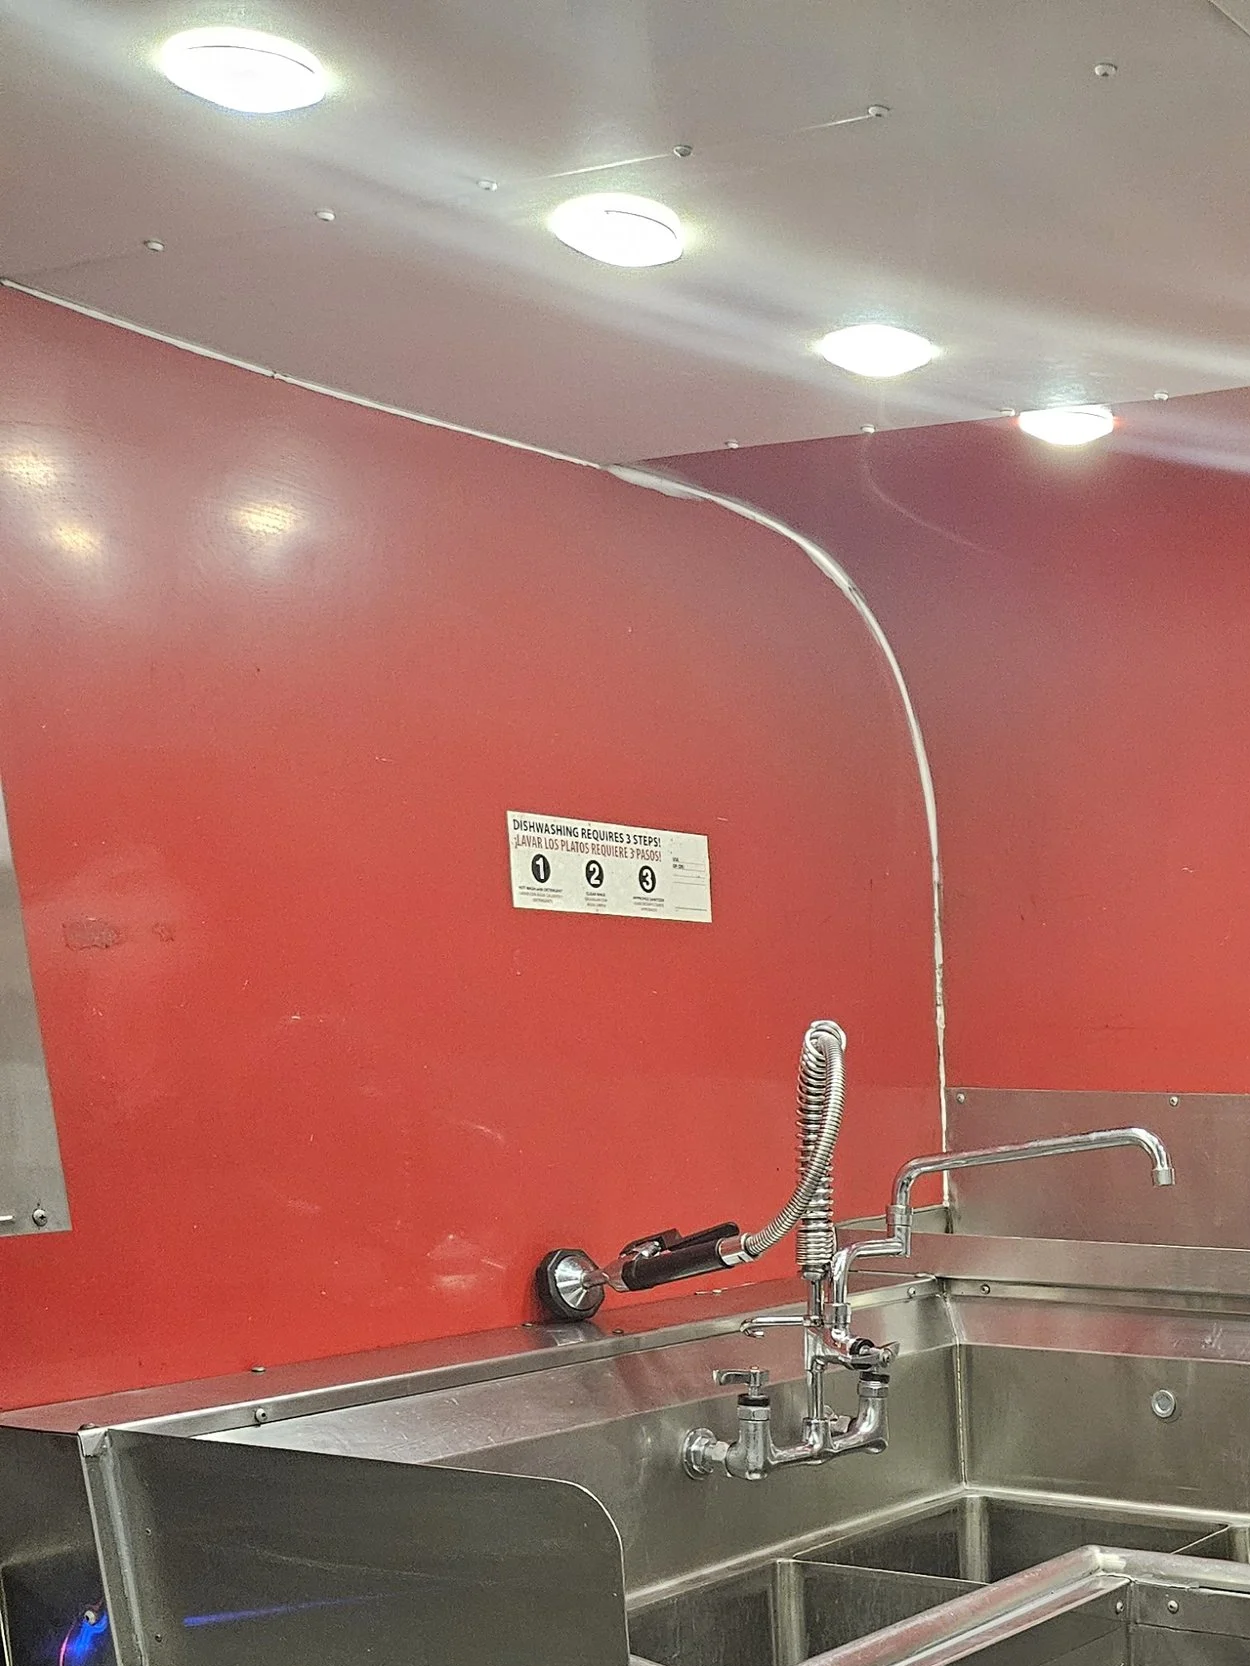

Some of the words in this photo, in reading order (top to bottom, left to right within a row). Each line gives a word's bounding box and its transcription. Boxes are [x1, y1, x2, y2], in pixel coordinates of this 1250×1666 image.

[513, 819, 579, 838] DISHWASHING
[581, 828, 624, 843] REQUIRES
[626, 833, 632, 844] 3
[633, 834, 661, 848] STEPS!
[514, 834, 543, 849] ¡LAVAR
[545, 838, 559, 850] LOS
[560, 839, 590, 854] PLATOS
[591, 843, 628, 858] REQUIERE
[629, 847, 635, 858] 3
[636, 849, 662, 862] PASOS!
[535, 856, 546, 880] 1
[588, 862, 602, 885] 2
[641, 868, 654, 891] 3
